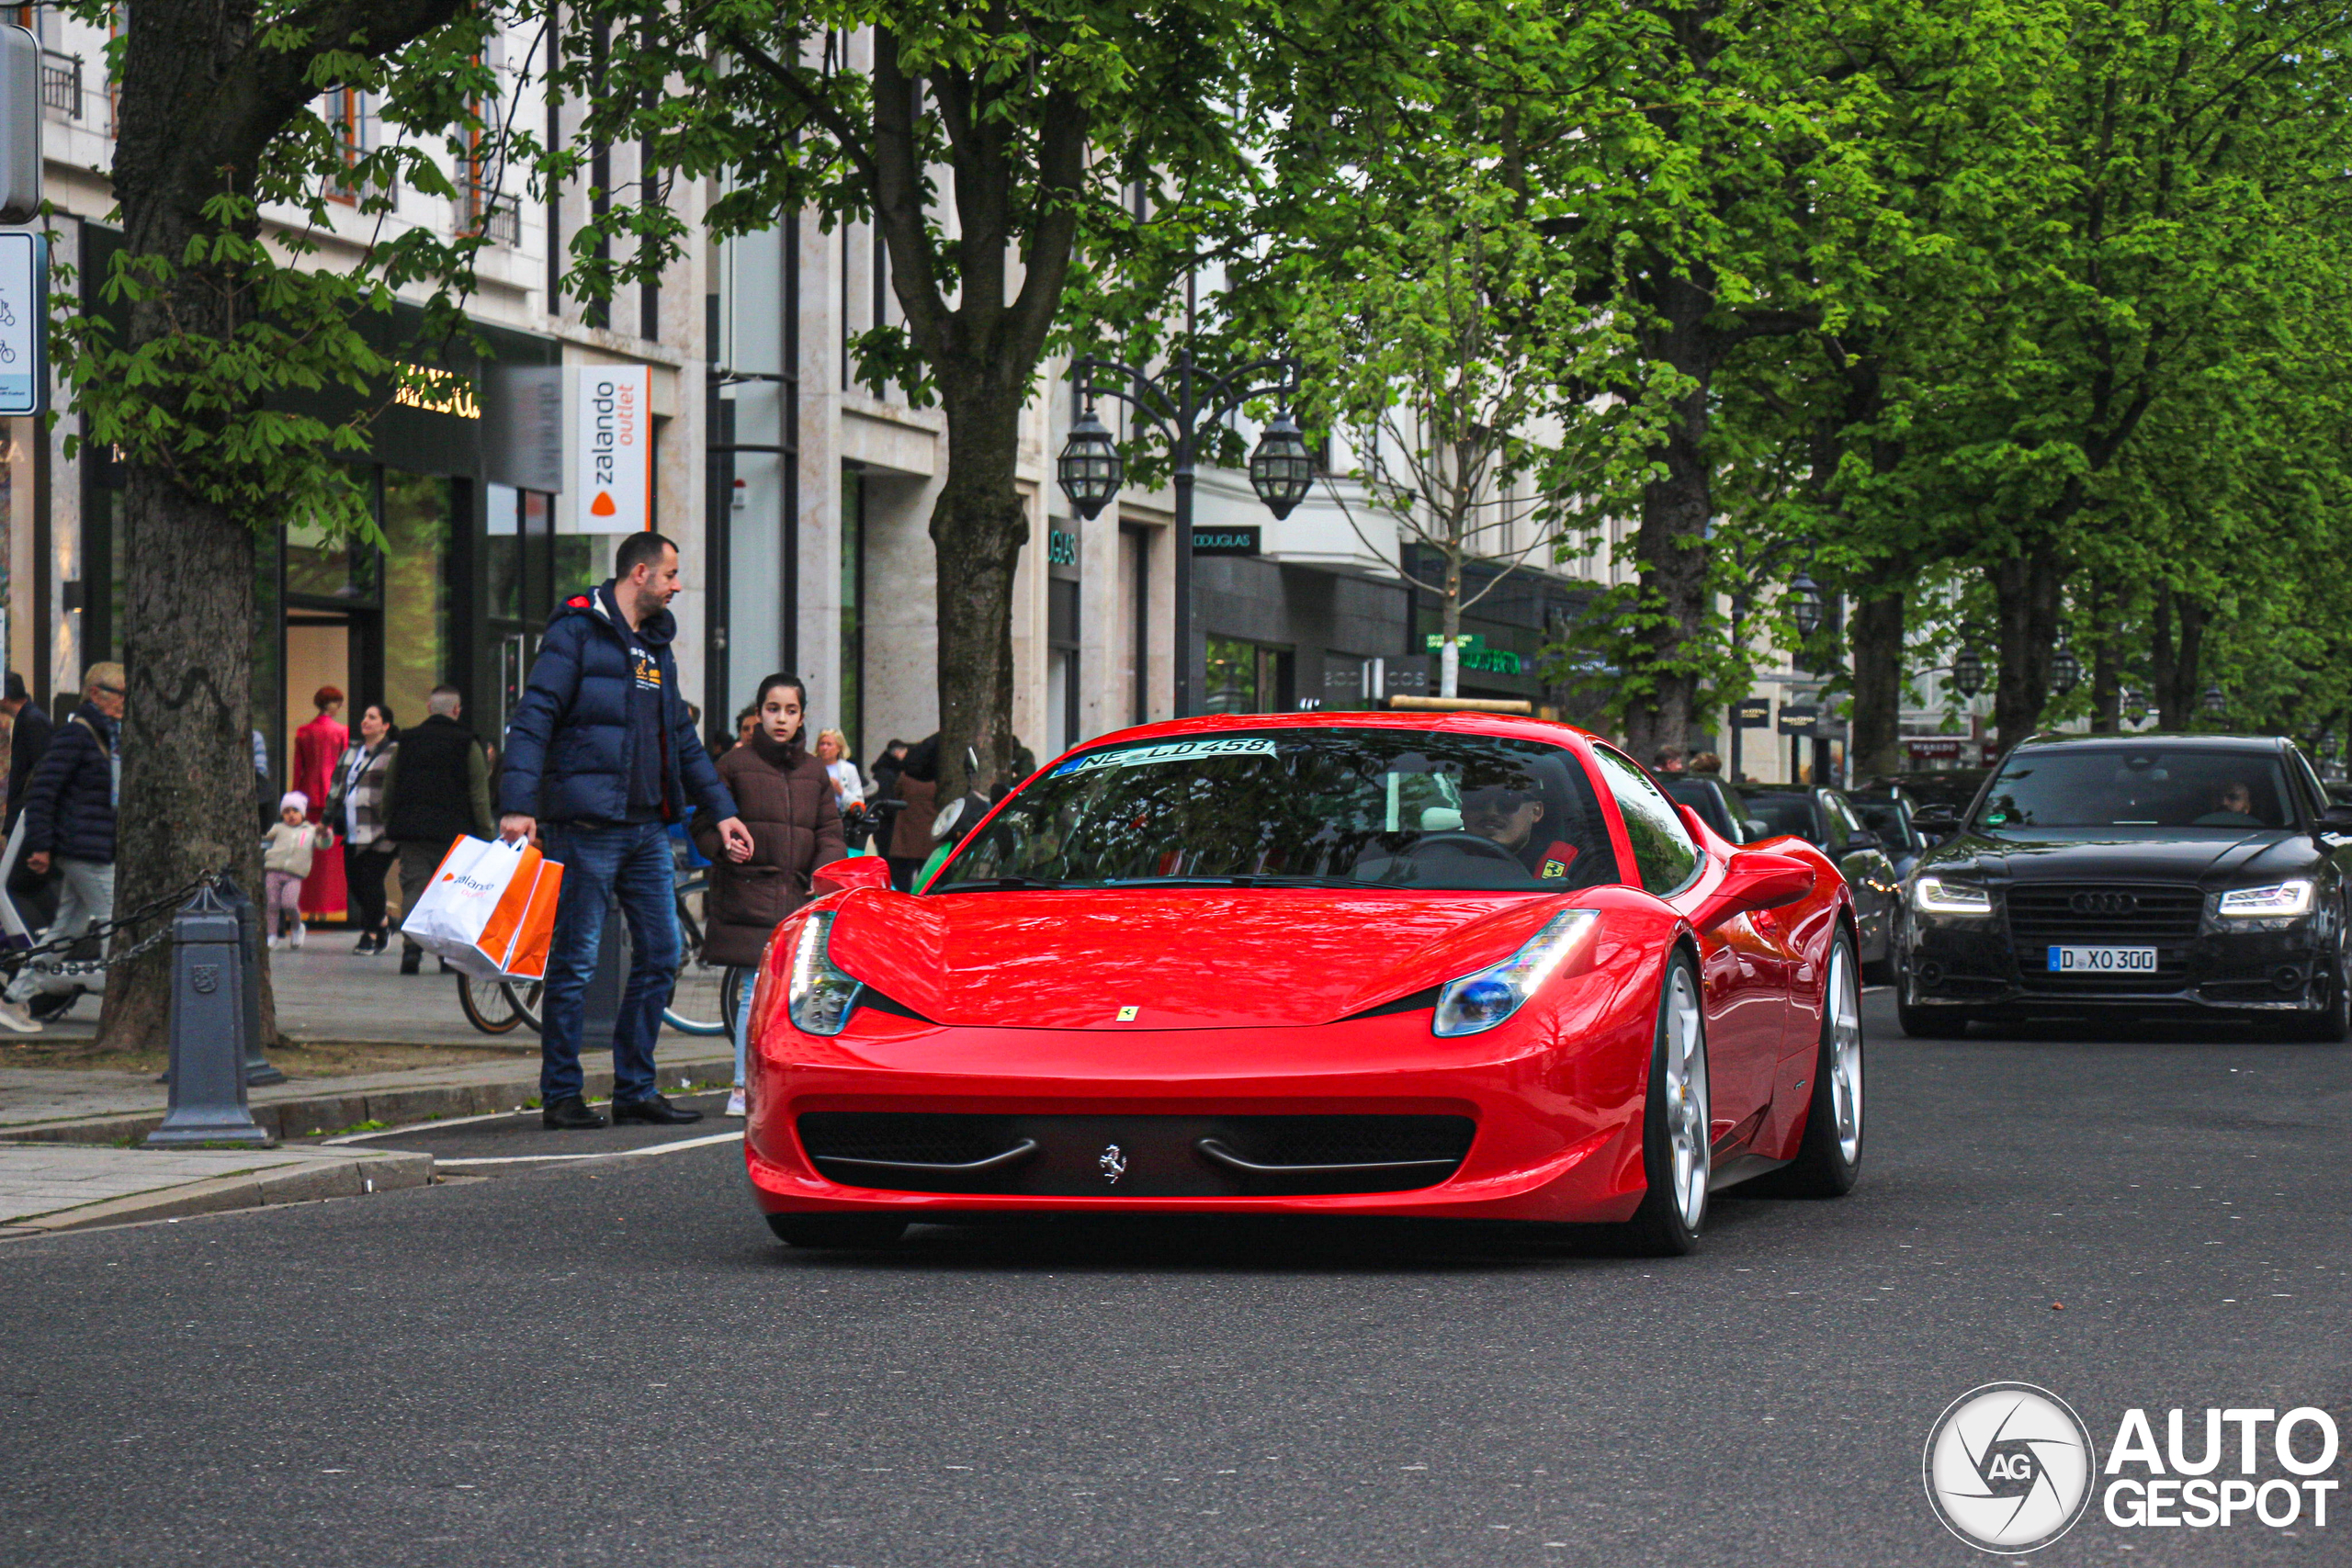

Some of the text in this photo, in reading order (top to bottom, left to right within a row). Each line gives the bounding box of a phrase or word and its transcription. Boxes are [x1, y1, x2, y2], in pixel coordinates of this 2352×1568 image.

[616, 384, 634, 446] outlet
[592, 381, 615, 485] zalando
[1193, 534, 1250, 547] DOUGLAS
[1387, 670, 1425, 686] COS
[1079, 739, 1270, 769] NE LD 458
[2062, 950, 2154, 969] D XO 300
